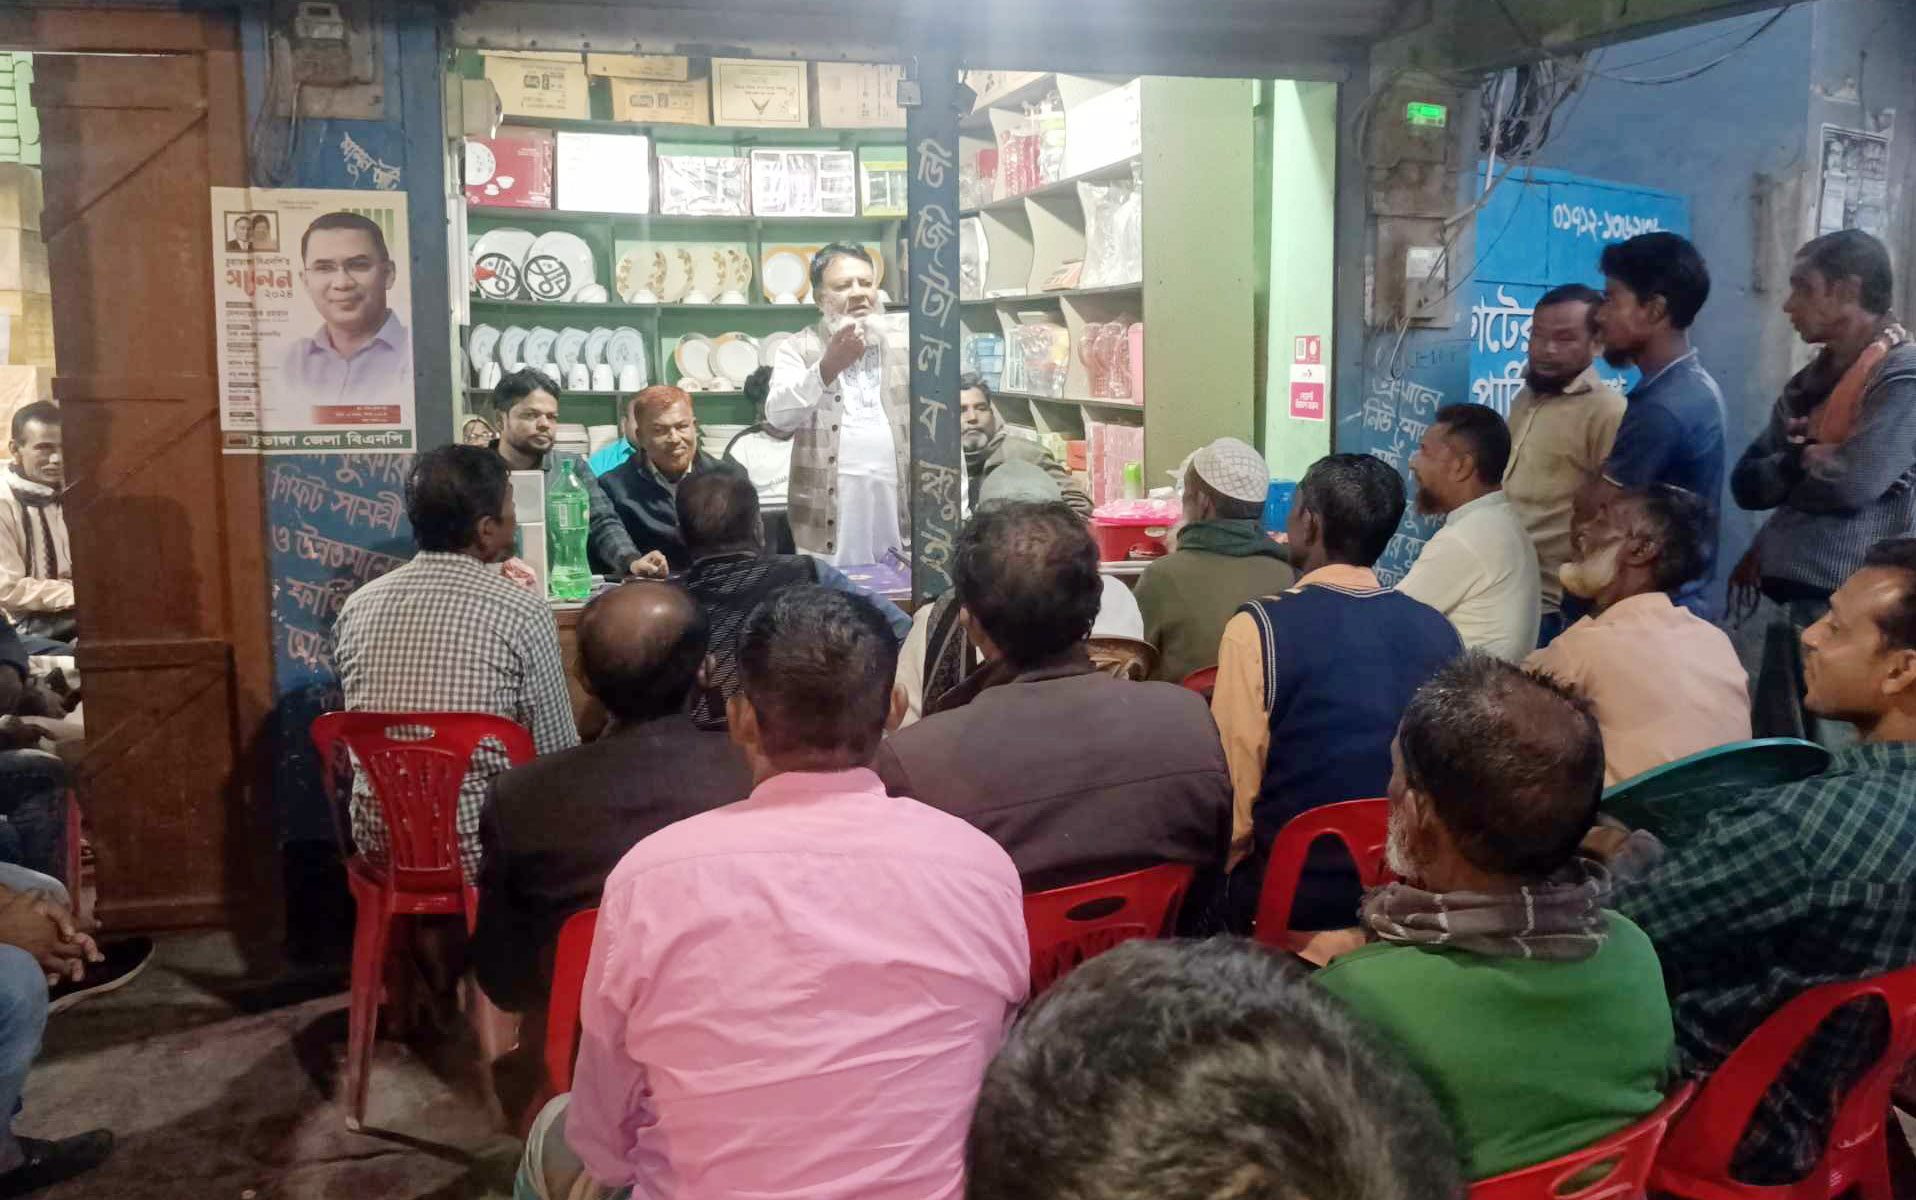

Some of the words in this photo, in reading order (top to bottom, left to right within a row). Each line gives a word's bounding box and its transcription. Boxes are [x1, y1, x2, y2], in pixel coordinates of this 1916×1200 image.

[1363, 397, 1397, 433] নিউ
[303, 434, 341, 447] জেলা
[346, 431, 404, 447] বিএনপি
[271, 524, 290, 552] ও
[295, 524, 410, 579] উন্নতমানে
